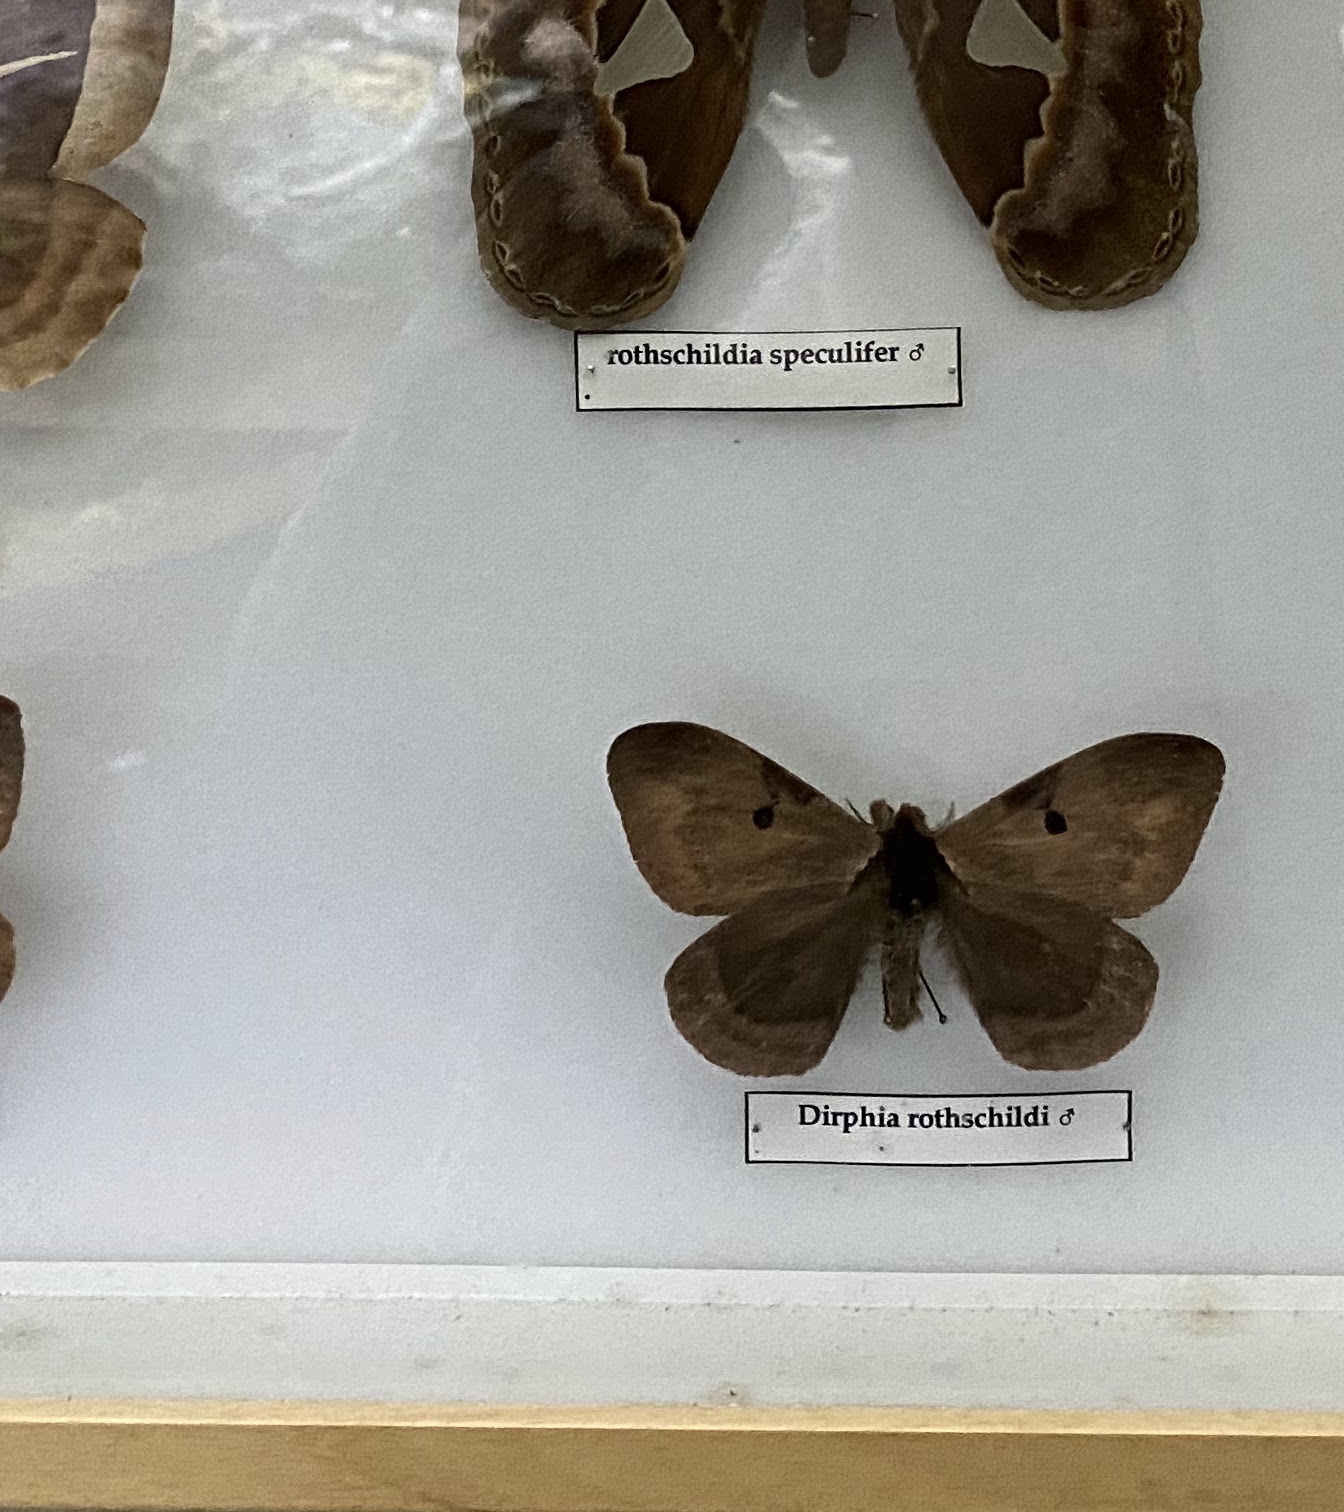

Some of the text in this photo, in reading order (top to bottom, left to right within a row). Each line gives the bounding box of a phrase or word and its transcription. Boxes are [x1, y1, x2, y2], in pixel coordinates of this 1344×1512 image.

[607, 341, 899, 371] rothschildia speculifer
[798, 1104, 1050, 1133] Dirphia rothschildi
